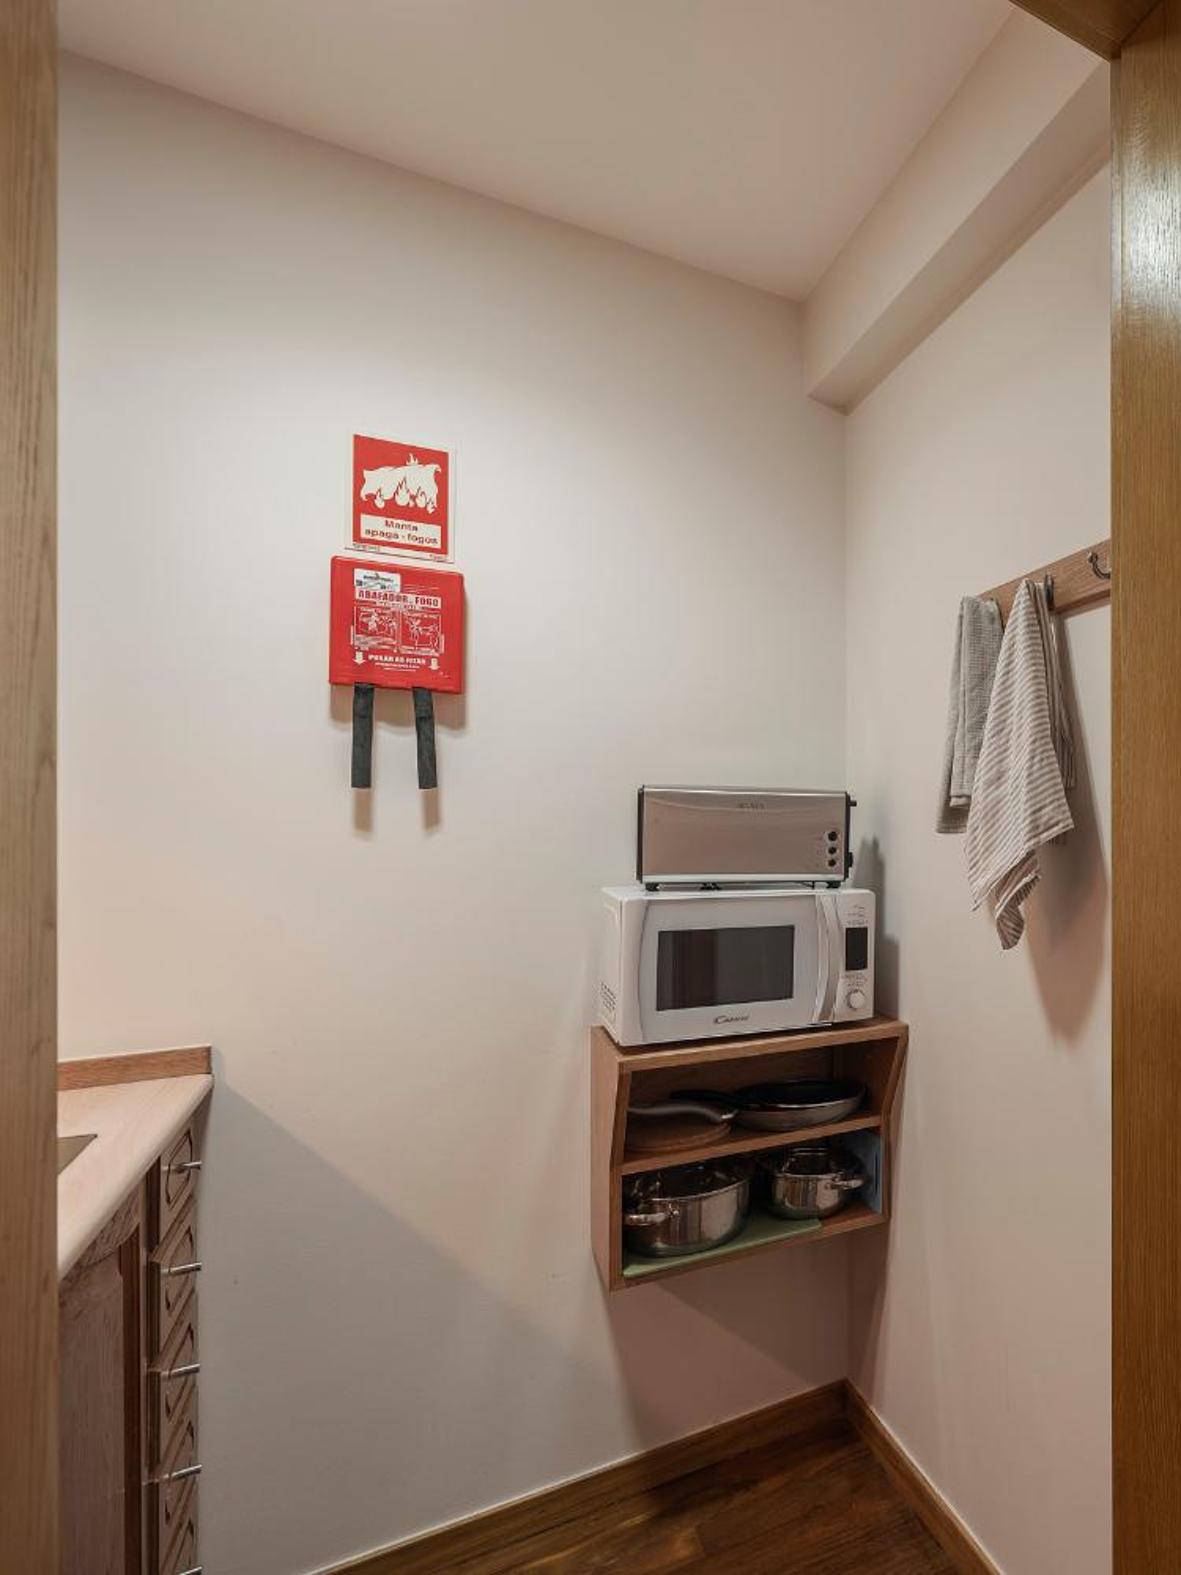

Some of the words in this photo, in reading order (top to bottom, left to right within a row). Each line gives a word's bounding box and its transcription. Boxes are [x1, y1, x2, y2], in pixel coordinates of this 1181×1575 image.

[385, 519, 418, 531] Manta
[365, 528, 399, 540] apaga
[407, 532, 439, 544] fogos
[415, 596, 439, 607] FOGO
